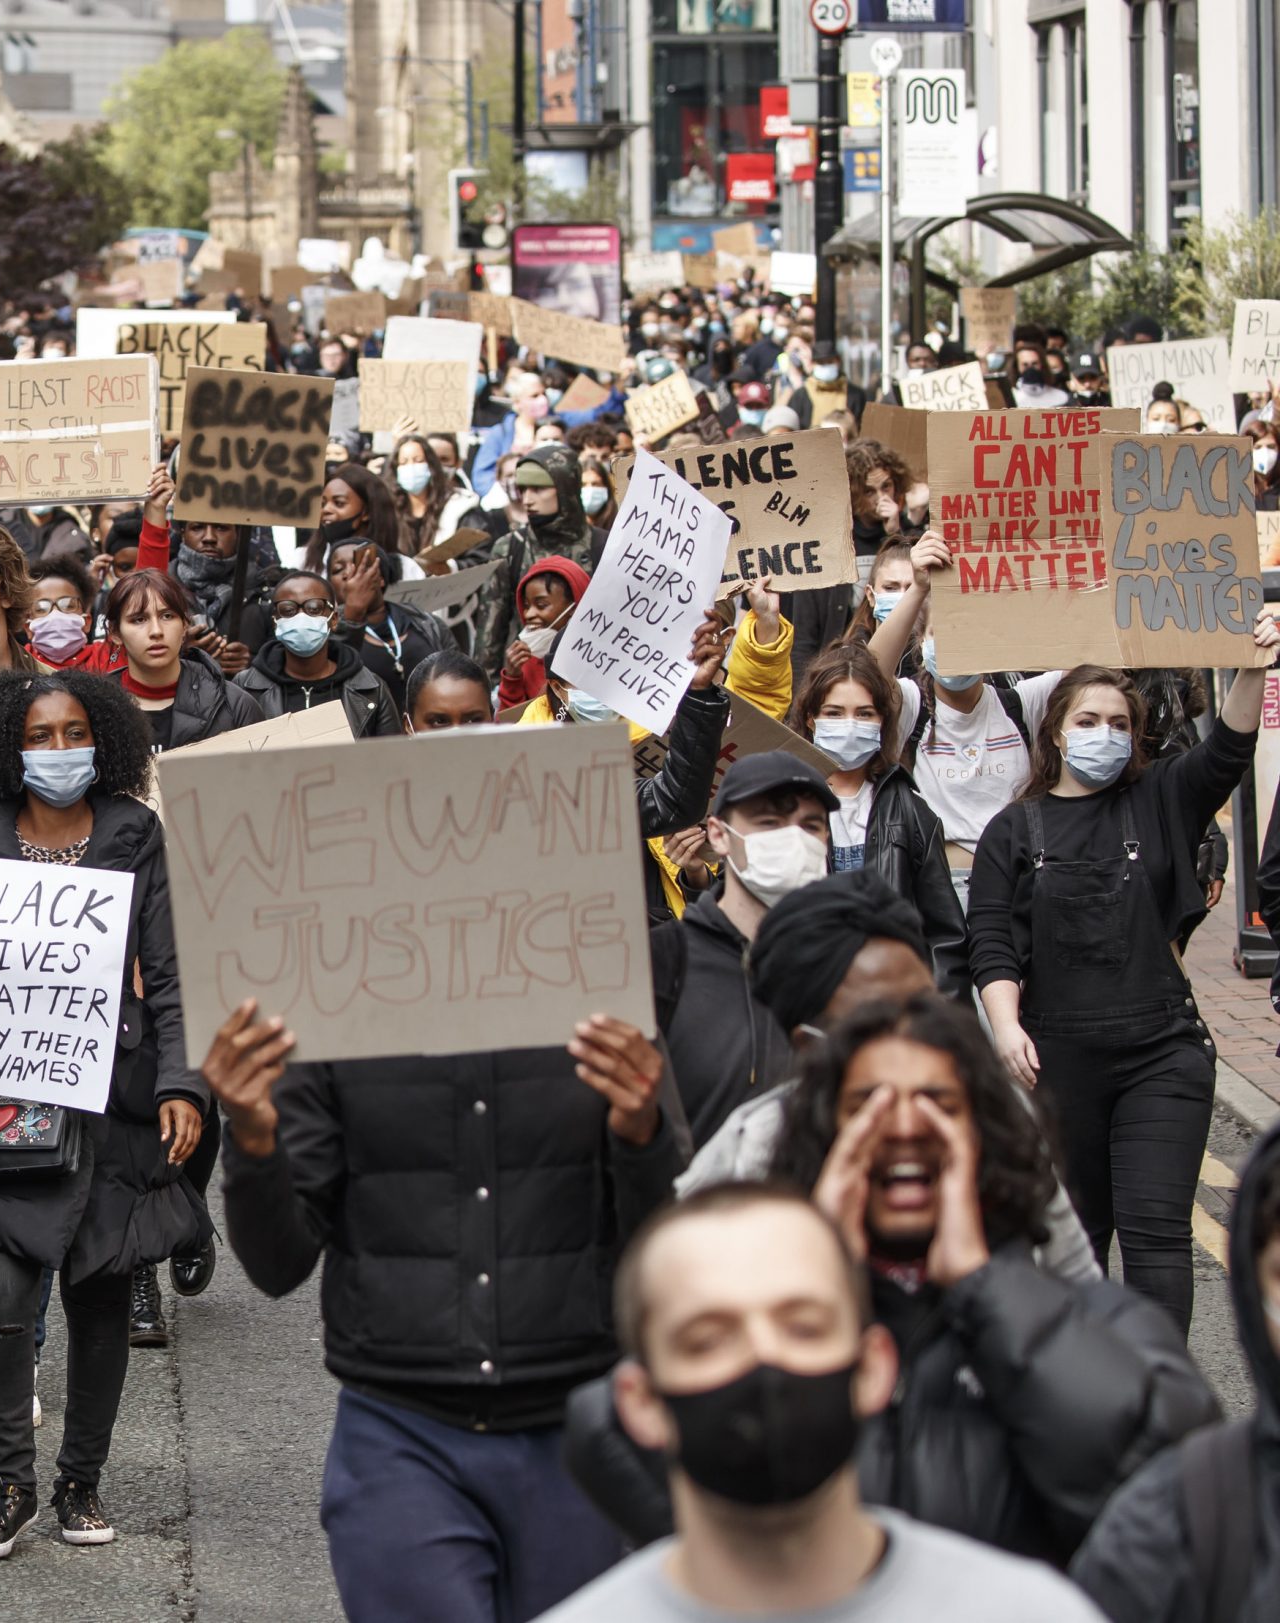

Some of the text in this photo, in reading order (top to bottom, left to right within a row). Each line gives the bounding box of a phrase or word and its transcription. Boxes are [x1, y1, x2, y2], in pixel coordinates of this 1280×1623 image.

[817, 5, 846, 20] 20
[116, 323, 218, 356] BLACK
[362, 361, 463, 390] BLACK
[1113, 344, 1218, 386] HOW MANY
[8, 377, 72, 411] LEAST
[86, 374, 146, 407] RACIST
[907, 371, 976, 405] BLACK
[922, 393, 981, 411] IVES
[968, 410, 1102, 442] ALL LIVES
[972, 441, 1090, 490] CAN'T
[1111, 439, 1257, 518] BLACK
[648, 473, 702, 531] THIS
[763, 489, 811, 528] BLM
[940, 489, 1038, 521] MATTER
[621, 504, 696, 567] MAMA
[942, 518, 1042, 554] BLACK
[1111, 514, 1238, 576] Lives
[617, 542, 697, 606] HEARS
[625, 585, 685, 634] YOU!
[1114, 570, 1265, 635] MATTER
[580, 607, 688, 688] MY PEOPLE
[571, 637, 671, 713] MUST LIVE
[1263, 677, 1279, 728] ENJOY
[937, 762, 1006, 780] ICONIC
[164, 763, 377, 921] WE
[385, 748, 633, 878] WANT
[214, 889, 631, 1017] JUSTICE
[20, 1029, 99, 1063] THEIR
